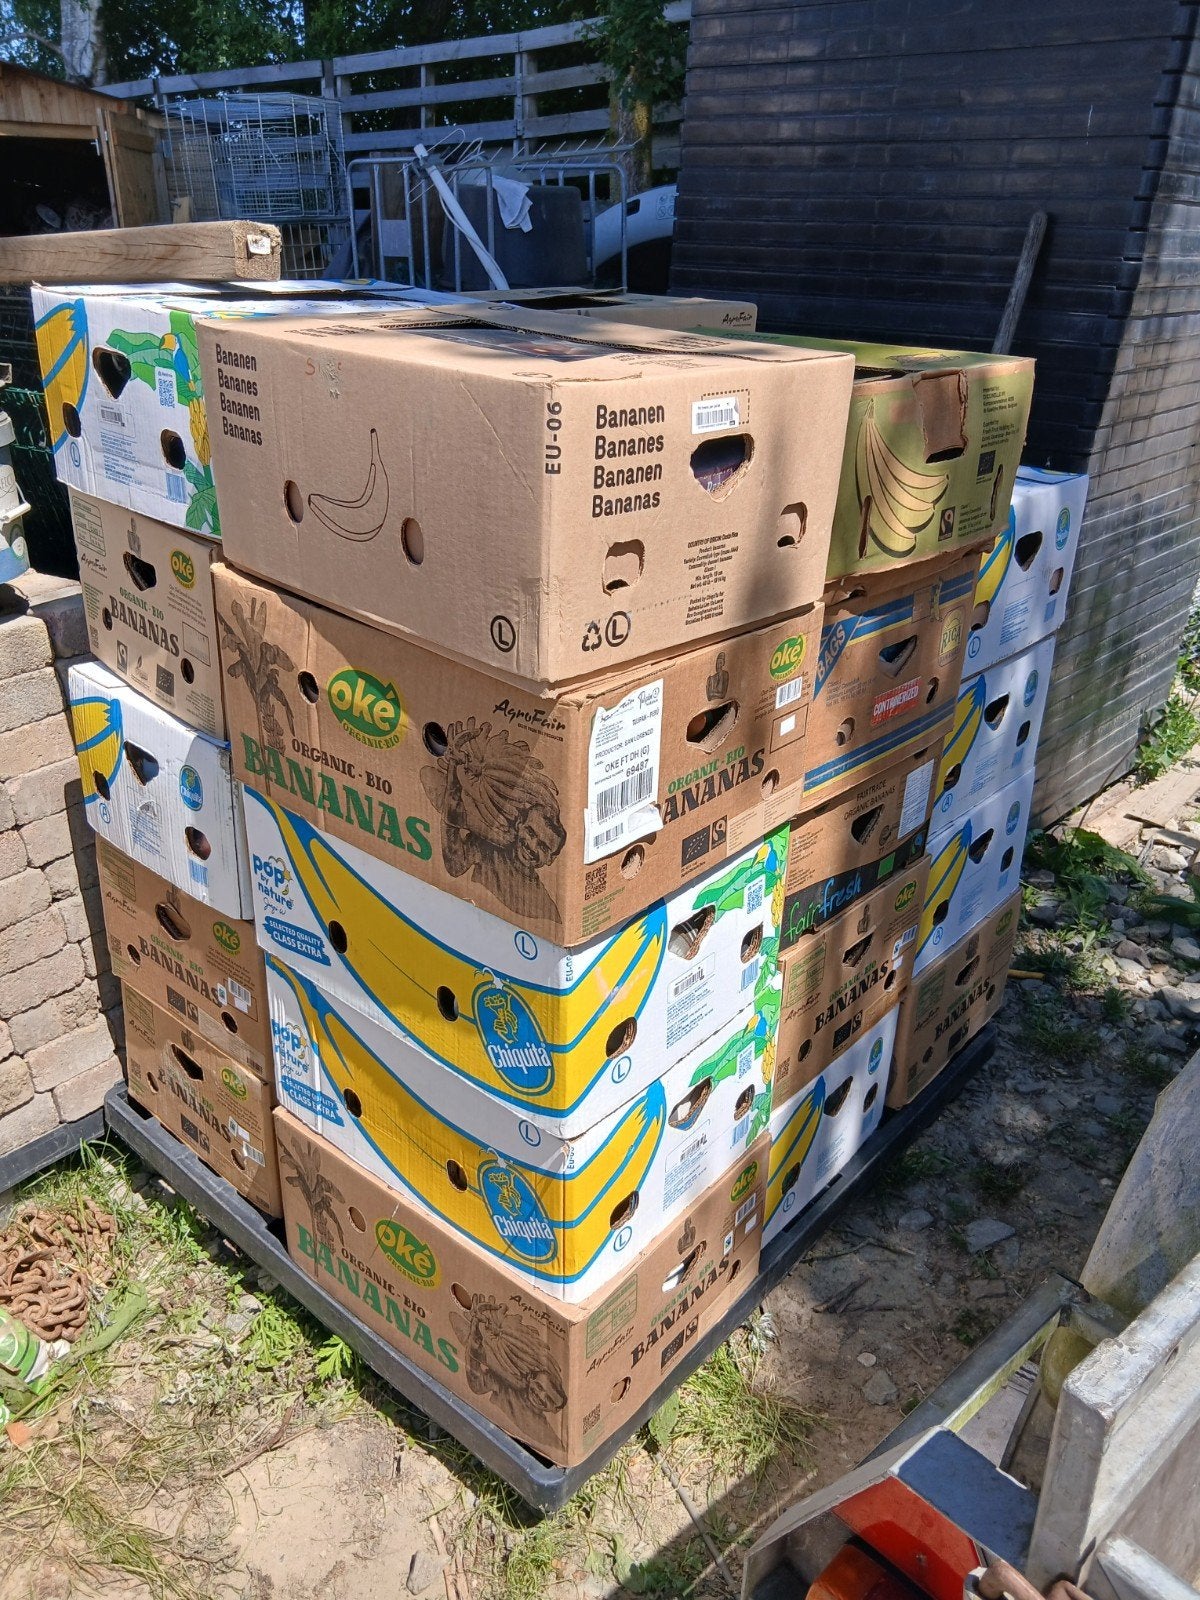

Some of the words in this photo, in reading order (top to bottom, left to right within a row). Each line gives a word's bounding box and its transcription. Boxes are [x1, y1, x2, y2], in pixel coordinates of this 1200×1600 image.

[216, 342, 257, 372] Bananen
[217, 367, 259, 397] Bananes
[220, 391, 261, 422] Bananen
[596, 403, 665, 430] Bananen
[222, 415, 263, 447] Bananas
[545, 401, 563, 476] EU-06
[595, 433, 665, 460] Bananes
[593, 463, 663, 490] Bananen
[592, 491, 661, 518] Bananas
[172, 555, 194, 579] oké
[120, 586, 148, 612] ORGANIC
[152, 609, 165, 622] BIO
[109, 595, 180, 658] BANANAS
[771, 638, 802, 670] oké
[816, 623, 847, 682] BAGS
[330, 676, 396, 732] oké
[493, 698, 566, 732] AgroFair
[291, 737, 356, 779] ORGANIC
[365, 770, 393, 796] BIO
[605, 759, 620, 774] OKE
[620, 755, 629, 768] FT
[630, 751, 640, 763] DH
[640, 744, 650, 759] (G)
[626, 758, 650, 778] 69487
[667, 758, 720, 794] ORGANIC
[726, 745, 745, 766] BIO
[240, 732, 433, 862] BANANAS
[663, 747, 766, 825] ANANAS
[844, 801, 870, 820] ORGANIC
[870, 785, 896, 806] BANANAS
[857, 778, 887, 802] FAIRTRADE
[252, 853, 286, 888] pop
[106, 890, 138, 916] AgroFair
[257, 881, 295, 911] nature
[213, 924, 241, 947] oké
[269, 920, 296, 937] SELECTED
[296, 931, 321, 947] QUALITY
[273, 931, 297, 950] CLASS
[297, 941, 323, 960] EXTRA
[138, 935, 224, 1009] BANANAS
[150, 934, 185, 963] ORGANIC
[189, 961, 205, 976] BIO
[813, 959, 890, 1036] BANANAS
[829, 973, 862, 1003] ORGANIC
[487, 1041, 553, 1075] Chiquita
[289, 1088, 312, 1107] CLASS
[493, 1213, 554, 1246] Chiquita
[378, 1223, 432, 1275] oké
[296, 1222, 460, 1374] BANANAS
[341, 1247, 396, 1296] ORGANIC
[403, 1296, 427, 1319] BIO
[650, 1284, 694, 1328] ORGANIC
[698, 1259, 715, 1279] BIO
[508, 1293, 567, 1335] AgroFair
[629, 1255, 731, 1369] BANANAS
[585, 1324, 636, 1378] AgroFair
